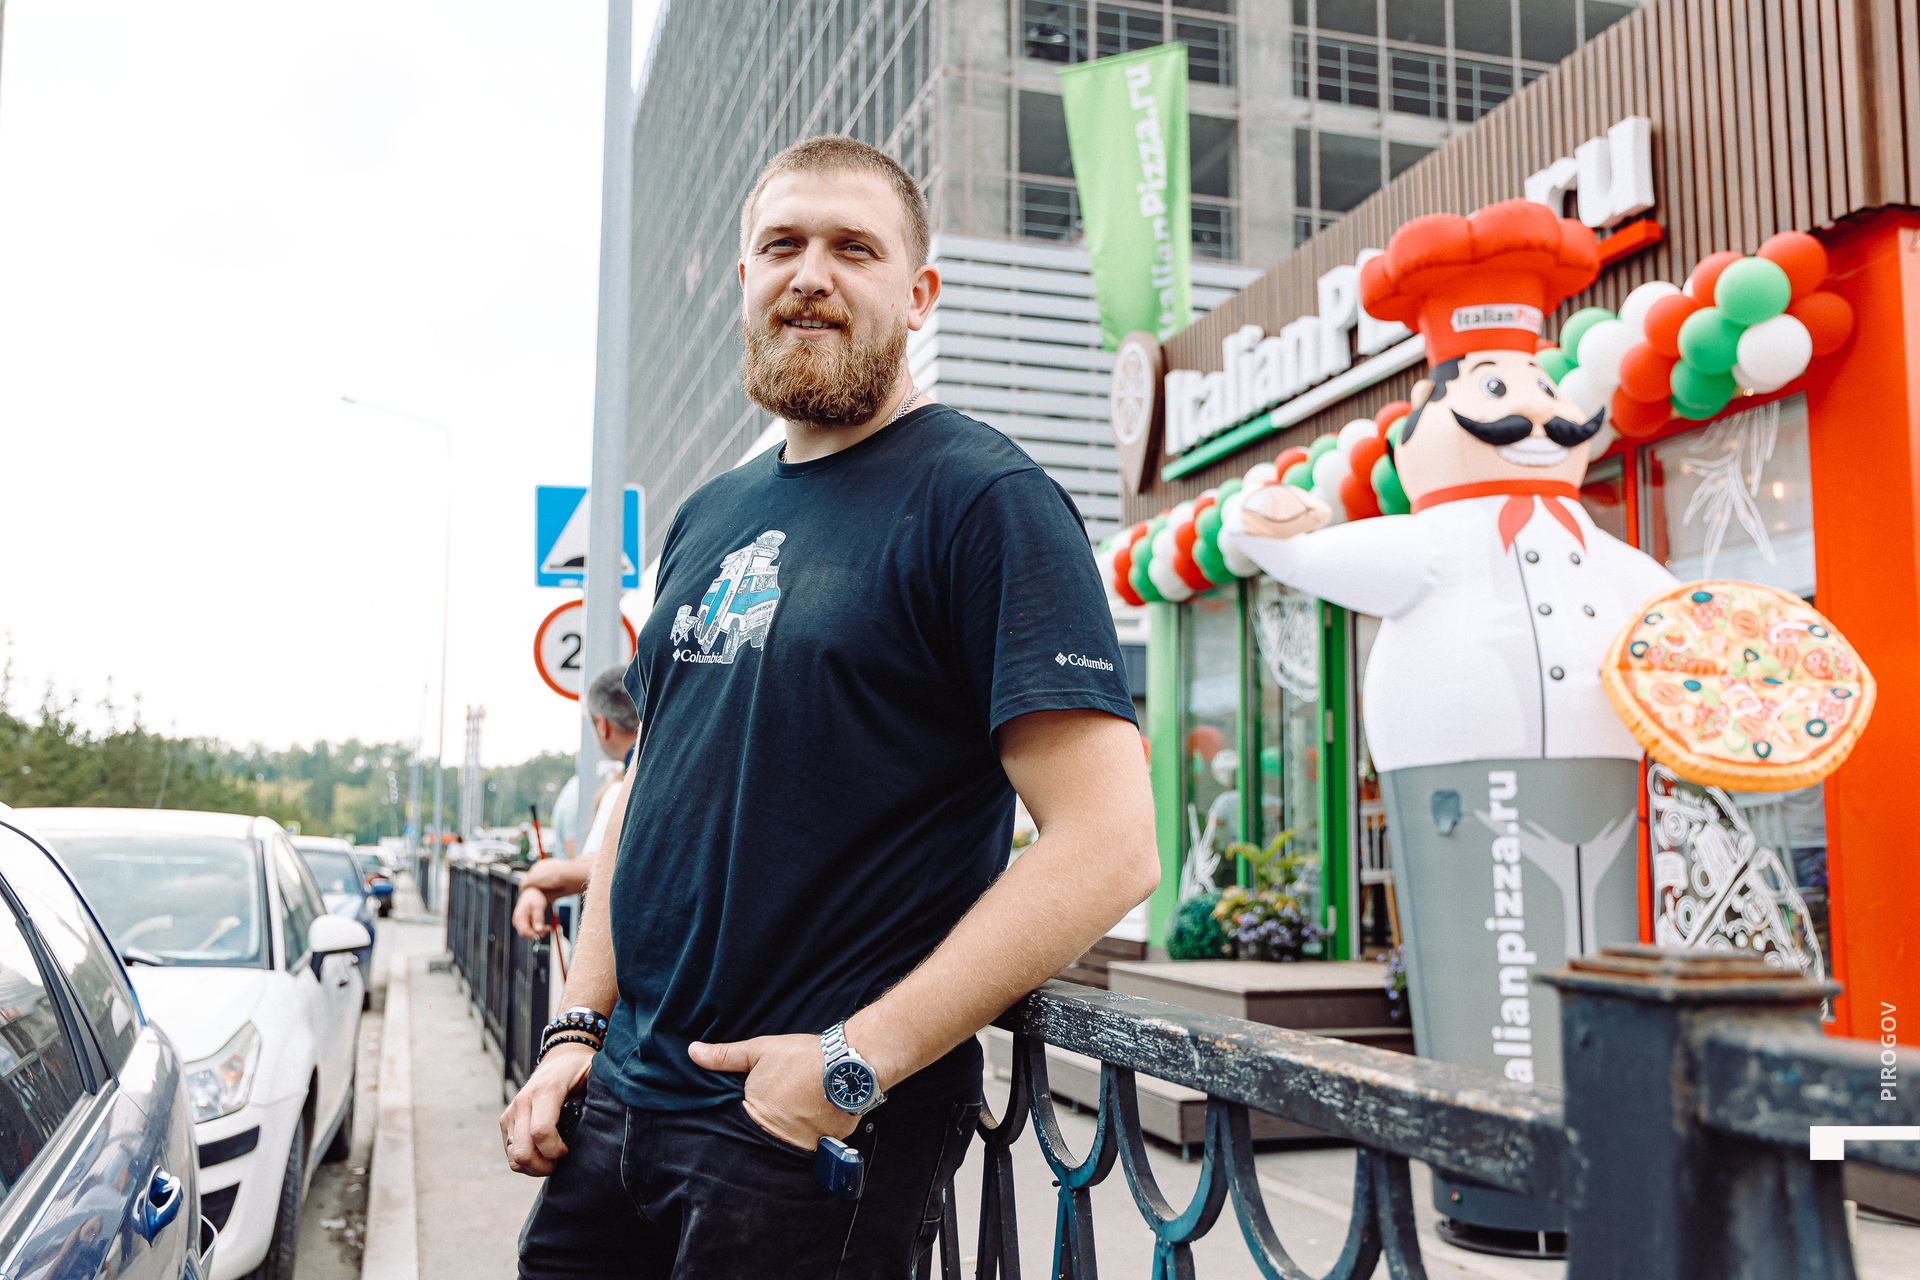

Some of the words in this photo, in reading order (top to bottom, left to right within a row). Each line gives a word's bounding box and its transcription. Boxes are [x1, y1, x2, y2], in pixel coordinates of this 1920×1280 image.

[560, 633, 582, 669] 2
[680, 649, 723, 664] Columbia
[1067, 653, 1114, 672] Columbia
[1484, 770, 1537, 1084] alianpizza.ru
